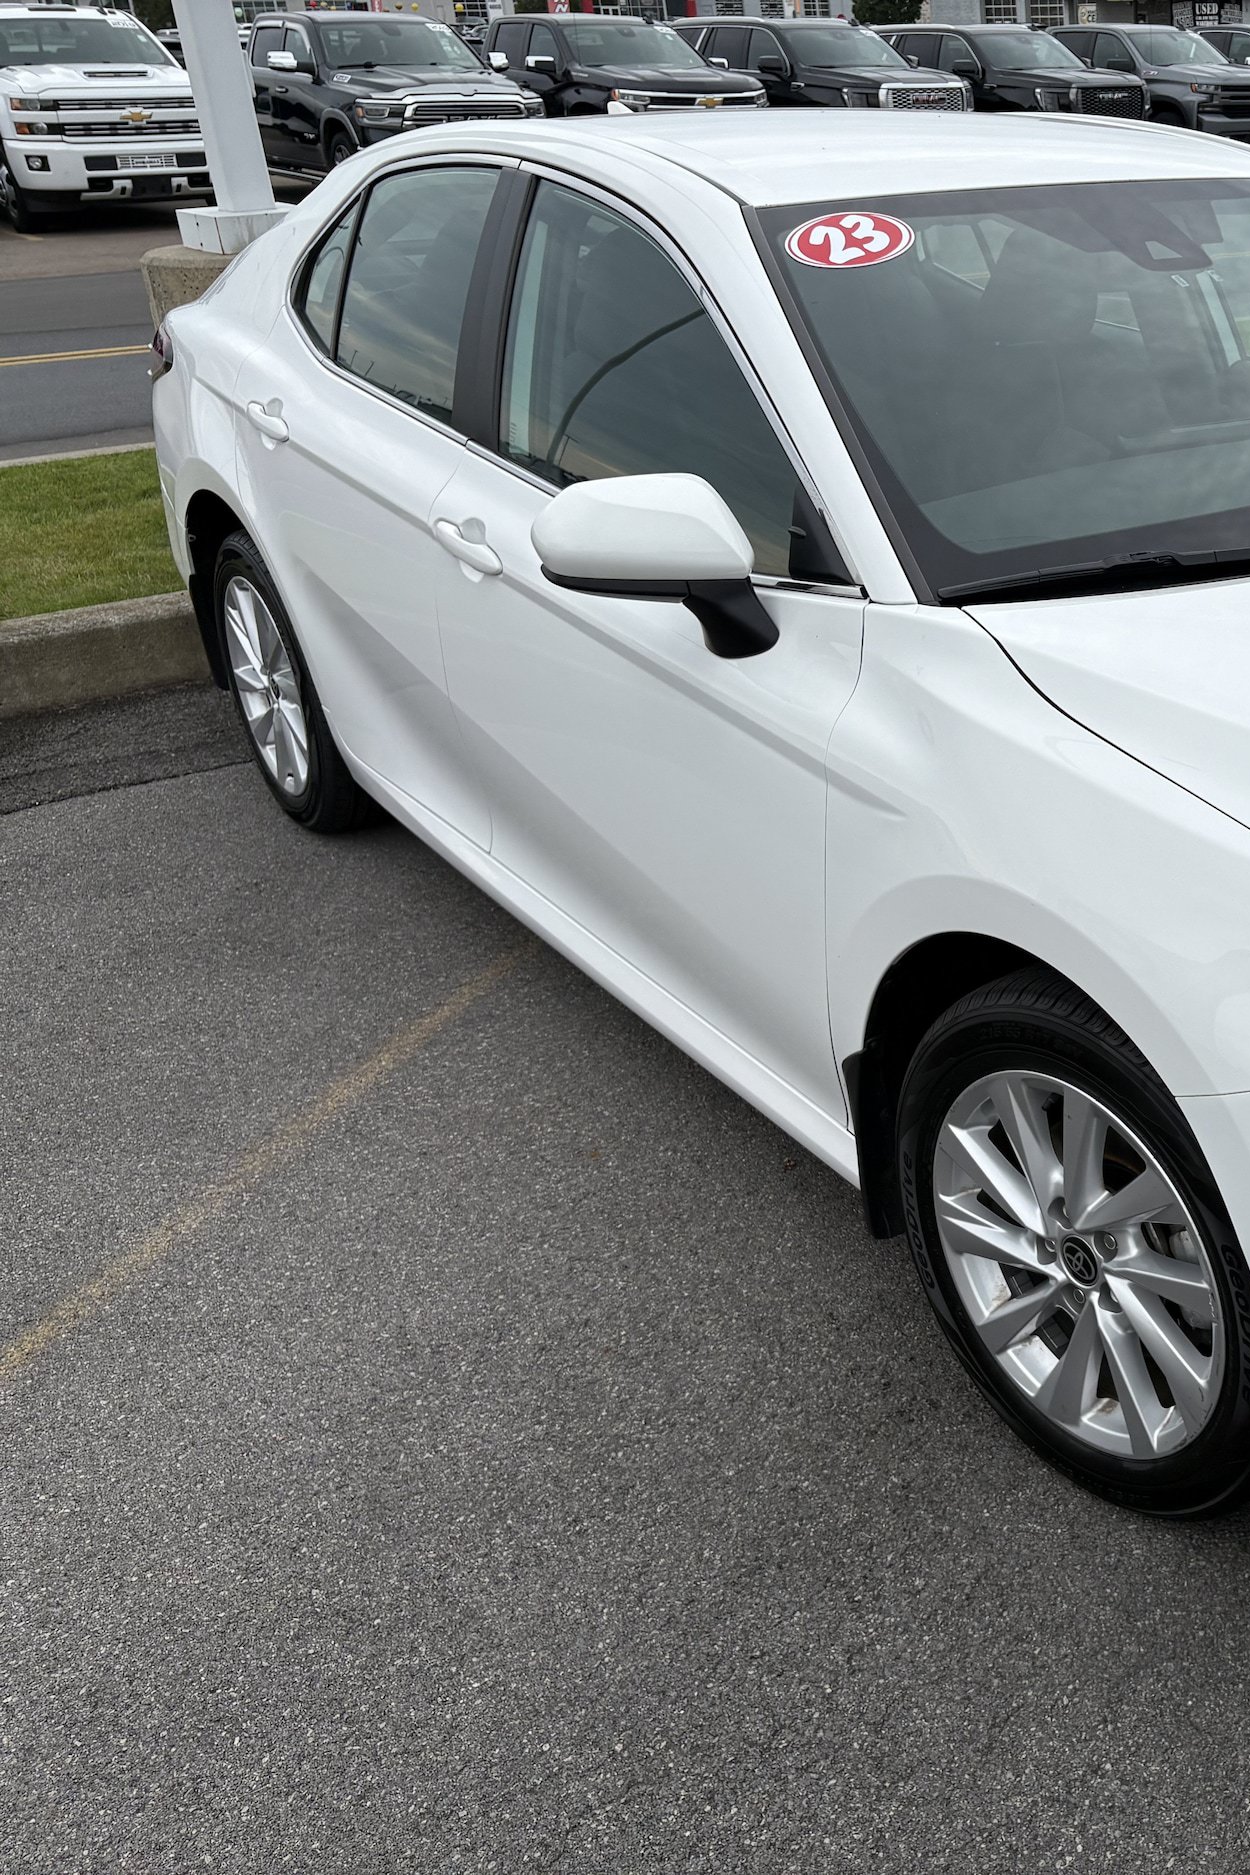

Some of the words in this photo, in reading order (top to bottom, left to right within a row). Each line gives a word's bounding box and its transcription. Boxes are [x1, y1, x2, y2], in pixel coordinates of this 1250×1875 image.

[1195, 3, 1219, 15] USED
[809, 214, 890, 264] 23
[903, 1151, 935, 1289] GeoDrive
